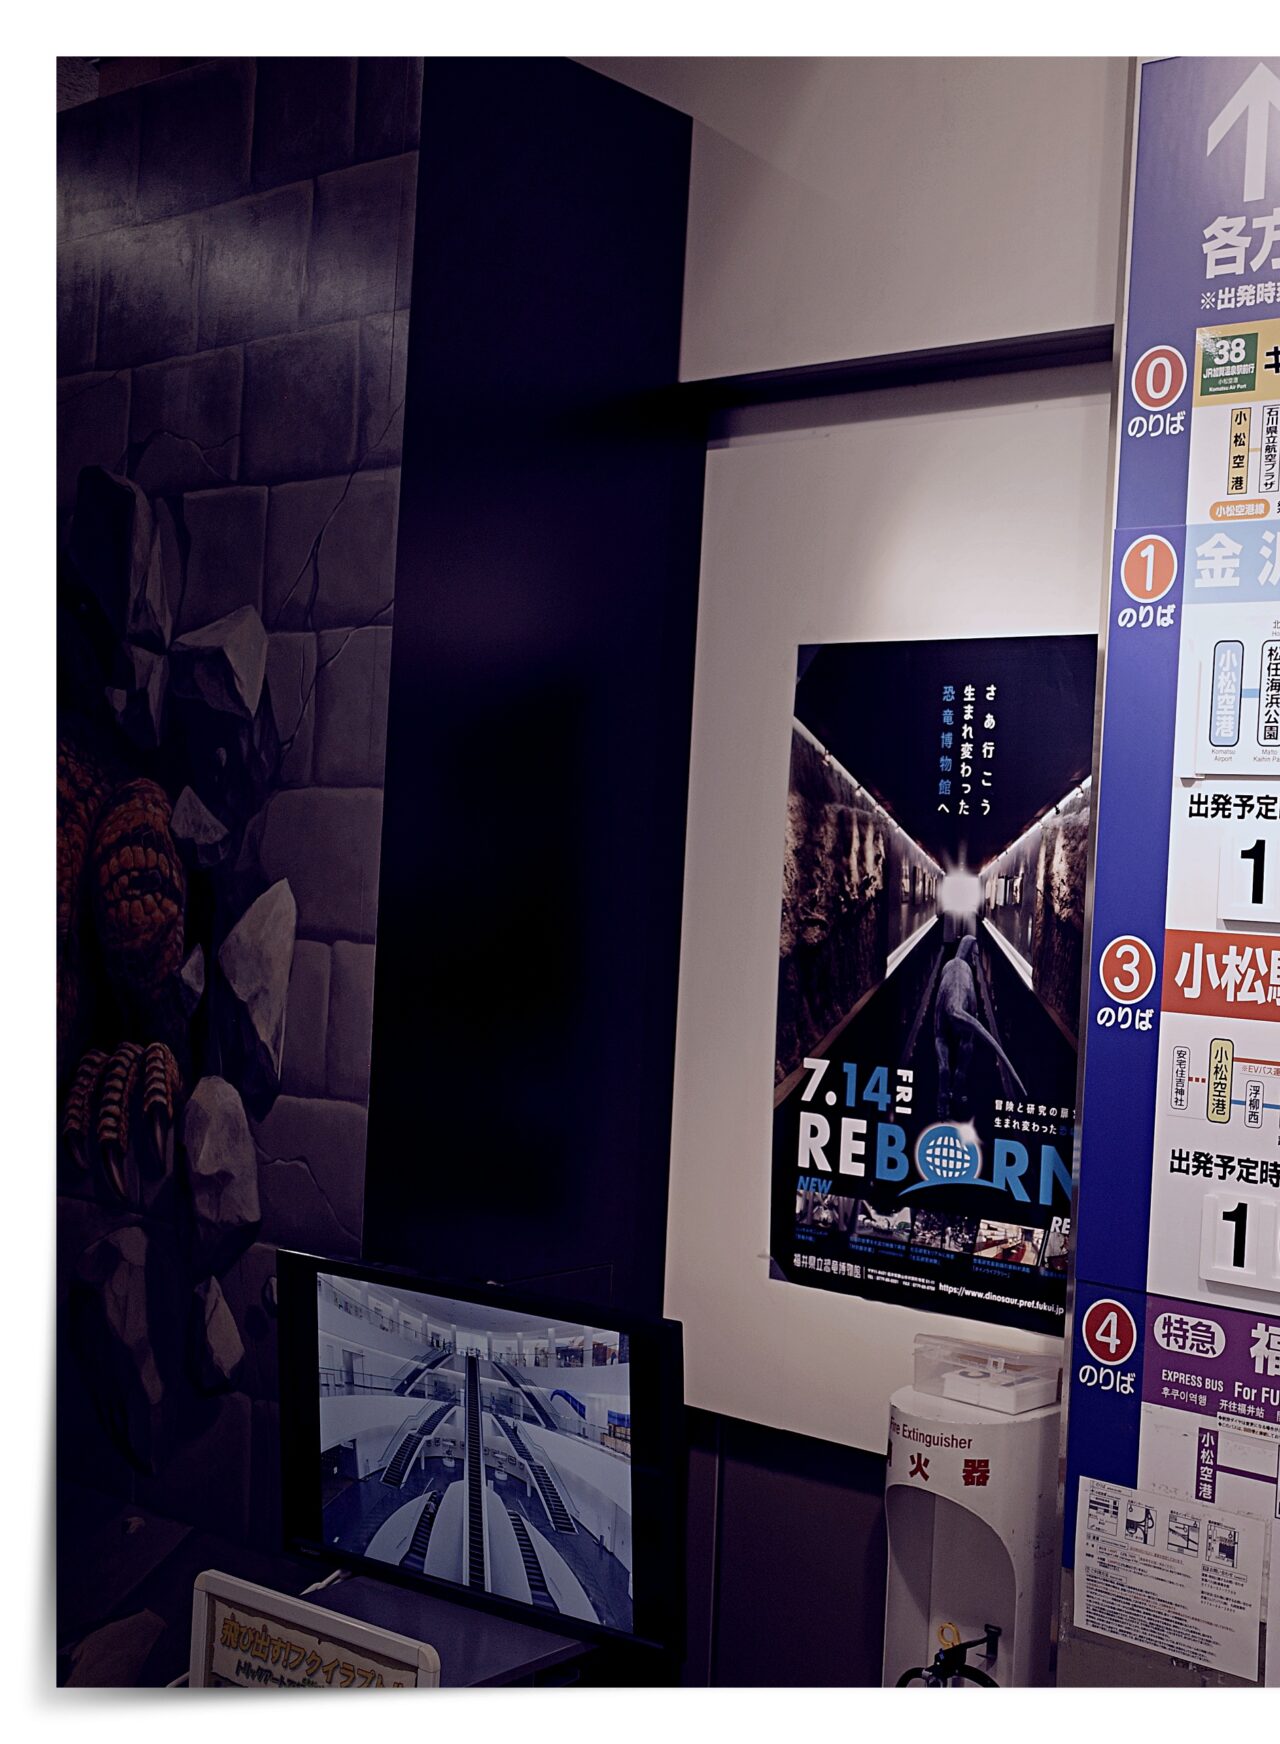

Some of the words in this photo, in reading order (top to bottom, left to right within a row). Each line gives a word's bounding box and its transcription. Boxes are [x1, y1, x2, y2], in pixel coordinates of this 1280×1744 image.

[1214, 338, 1246, 365] 38
[1146, 357, 1172, 399] 0
[1127, 411, 1186, 438] のりば
[1231, 410, 1248, 490] 小松空港
[1263, 406, 1279, 490] 石川県立航空プラザ
[1134, 543, 1153, 592] 1
[1118, 603, 1175, 629] のりば
[1214, 649, 1238, 738] 小松空港
[938, 685, 955, 813] 恐竜博物館へ
[958, 684, 975, 815] 生まれ変わった
[981, 684, 997, 815] さあ行こう
[1113, 944, 1140, 994] 3
[1096, 1006, 1154, 1032] のりば
[801, 1057, 891, 1112] 7.14
[895, 1069, 913, 1115] FRI
[1174, 1050, 1188, 1107] 安宅住吉神社
[1211, 1045, 1229, 1116] 小松空港
[1248, 1085, 1261, 1124] 浮柳西
[798, 1175, 832, 1194] NEW
[1095, 1312, 1121, 1354] 4
[1161, 1316, 1218, 1357] 特急
[1078, 1365, 1135, 1395] のりば
[1162, 1369, 1203, 1388] EXPRESS
[1205, 1376, 1224, 1393] BUS
[1234, 1382, 1258, 1400] For
[1219, 1399, 1265, 1419] 开往福井站
[902, 1424, 973, 1449] Extinguisher
[1199, 1431, 1216, 1499] 小松空港
